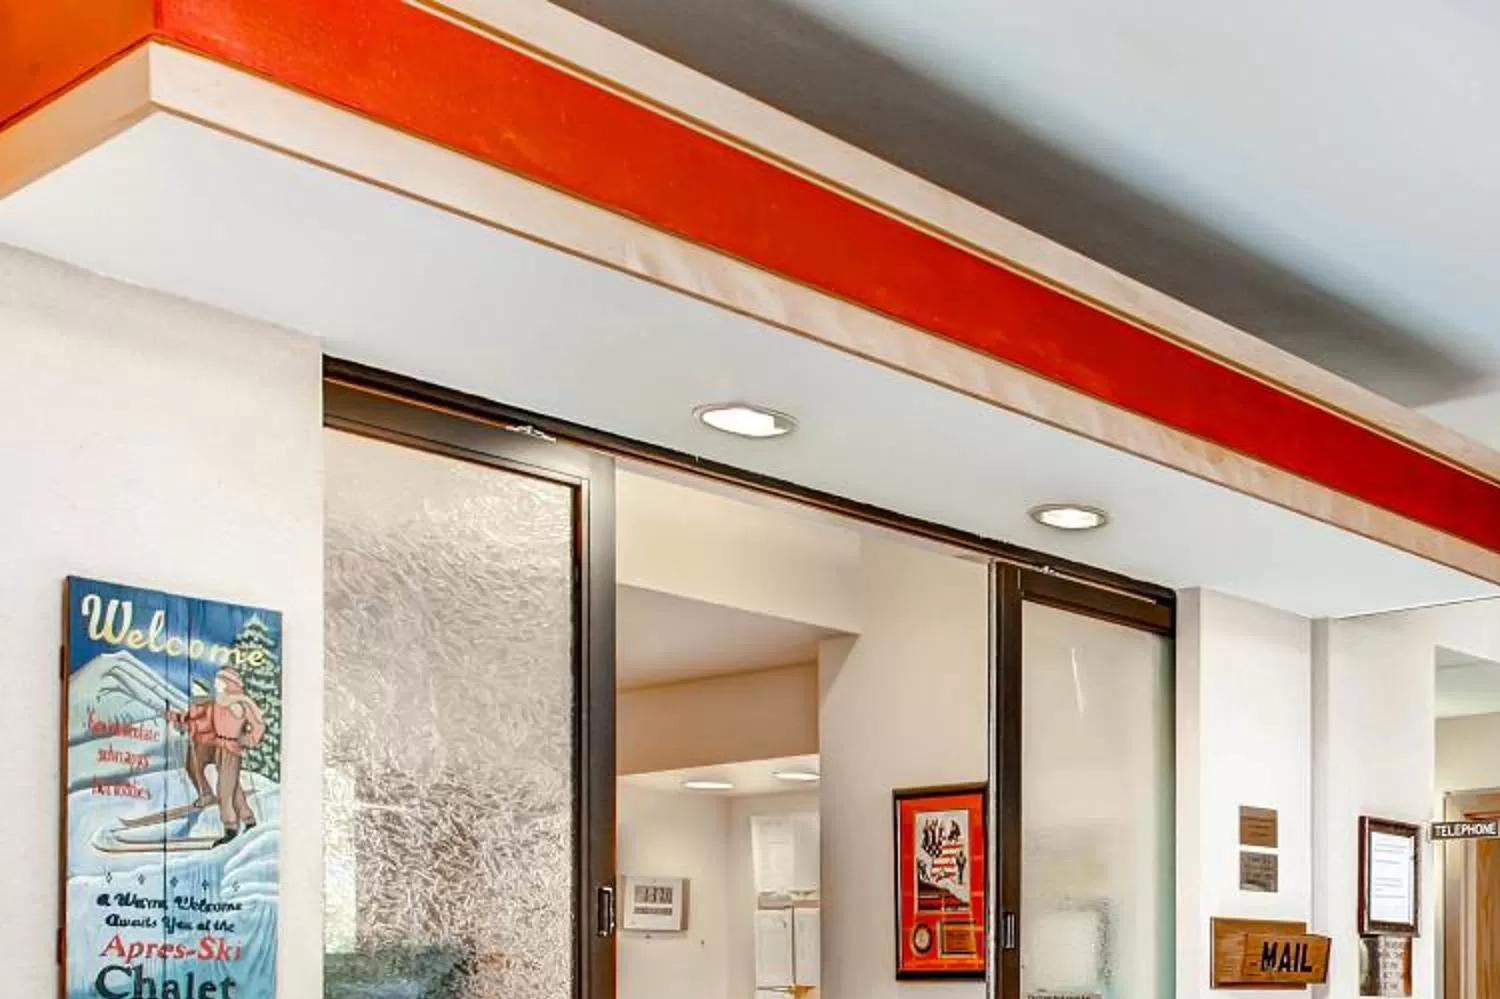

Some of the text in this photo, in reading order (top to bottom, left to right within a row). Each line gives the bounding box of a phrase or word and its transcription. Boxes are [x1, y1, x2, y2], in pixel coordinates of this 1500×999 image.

[81, 594, 267, 667] Welcome
[1435, 823, 1498, 837] TELEPHONE
[113, 892, 168, 910] Warm
[174, 895, 243, 912] Welcome
[105, 913, 236, 934] Awaits You at the
[99, 932, 244, 963] Apres-Ski
[1259, 941, 1313, 974] MAIL
